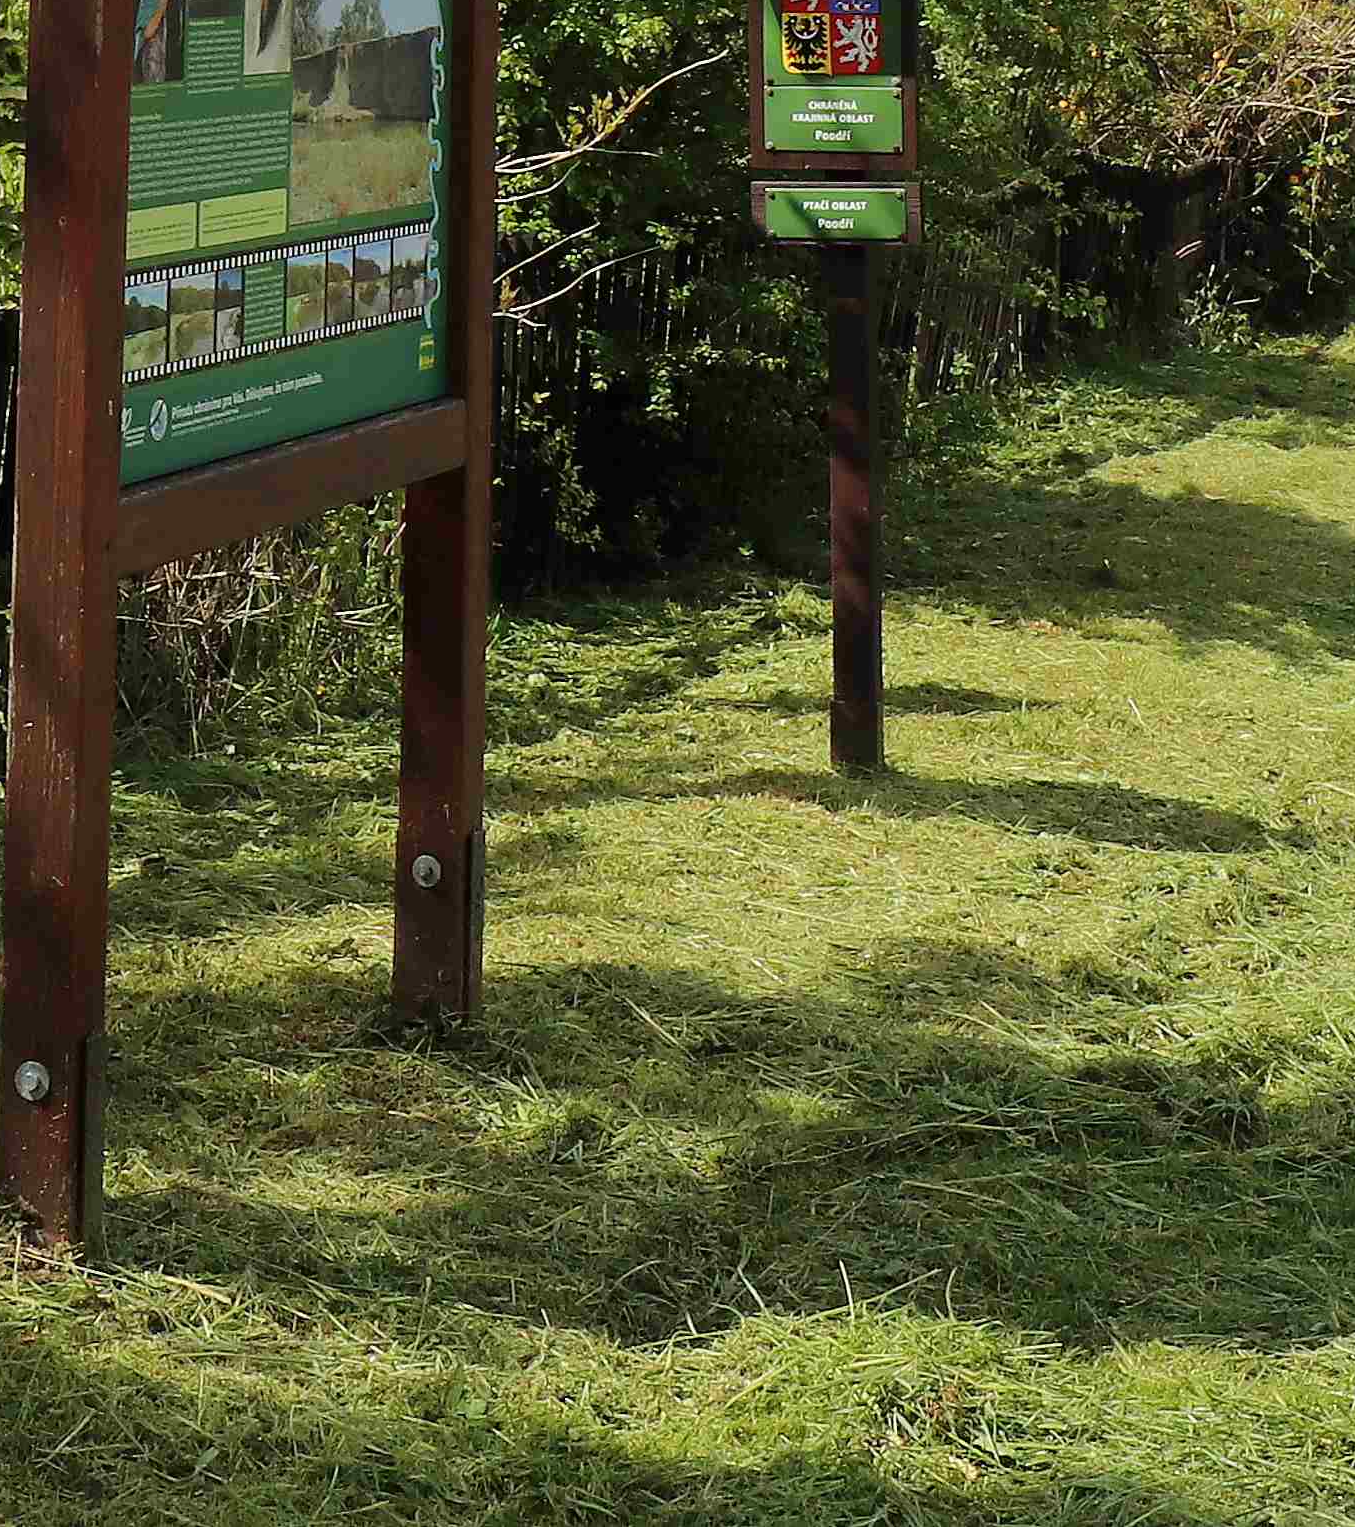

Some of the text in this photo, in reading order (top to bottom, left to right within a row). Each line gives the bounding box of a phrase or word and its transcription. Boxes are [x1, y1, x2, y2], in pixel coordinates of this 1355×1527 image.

[839, 113, 875, 123] OBLAST
[815, 130, 852, 141] Poodří
[831, 201, 868, 211] OBLAST
[818, 218, 854, 229] Poodří
